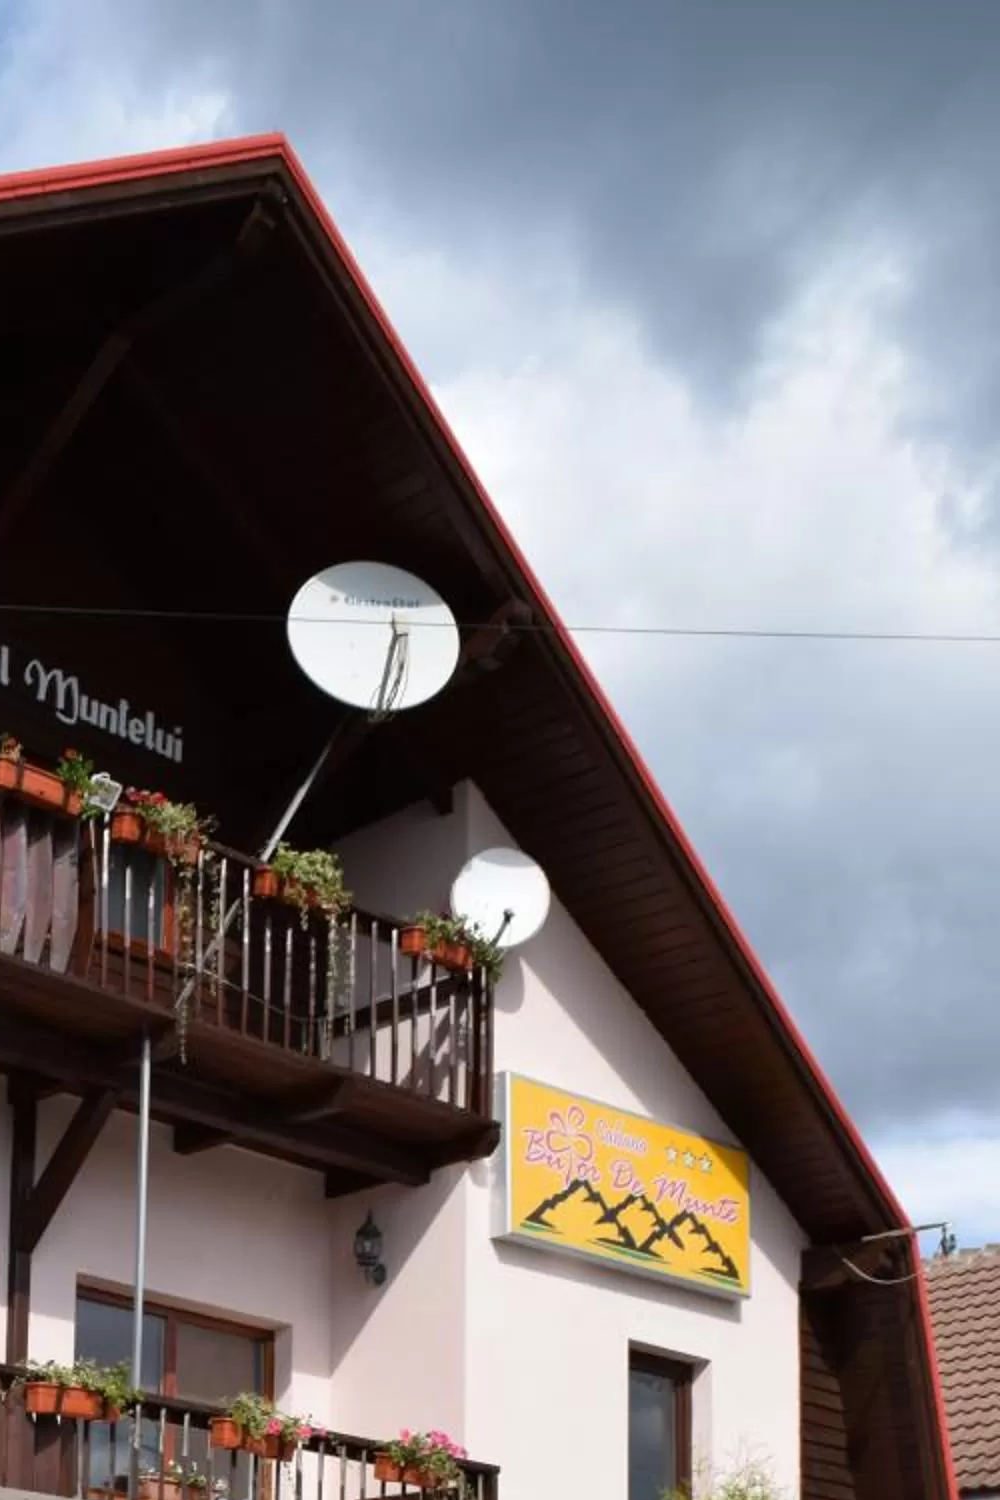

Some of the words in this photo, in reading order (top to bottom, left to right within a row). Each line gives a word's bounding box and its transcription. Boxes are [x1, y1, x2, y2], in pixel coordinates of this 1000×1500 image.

[23, 658, 184, 763] Muntelui
[611, 1160, 648, 1196] De
[654, 1176, 741, 1223] Munte
